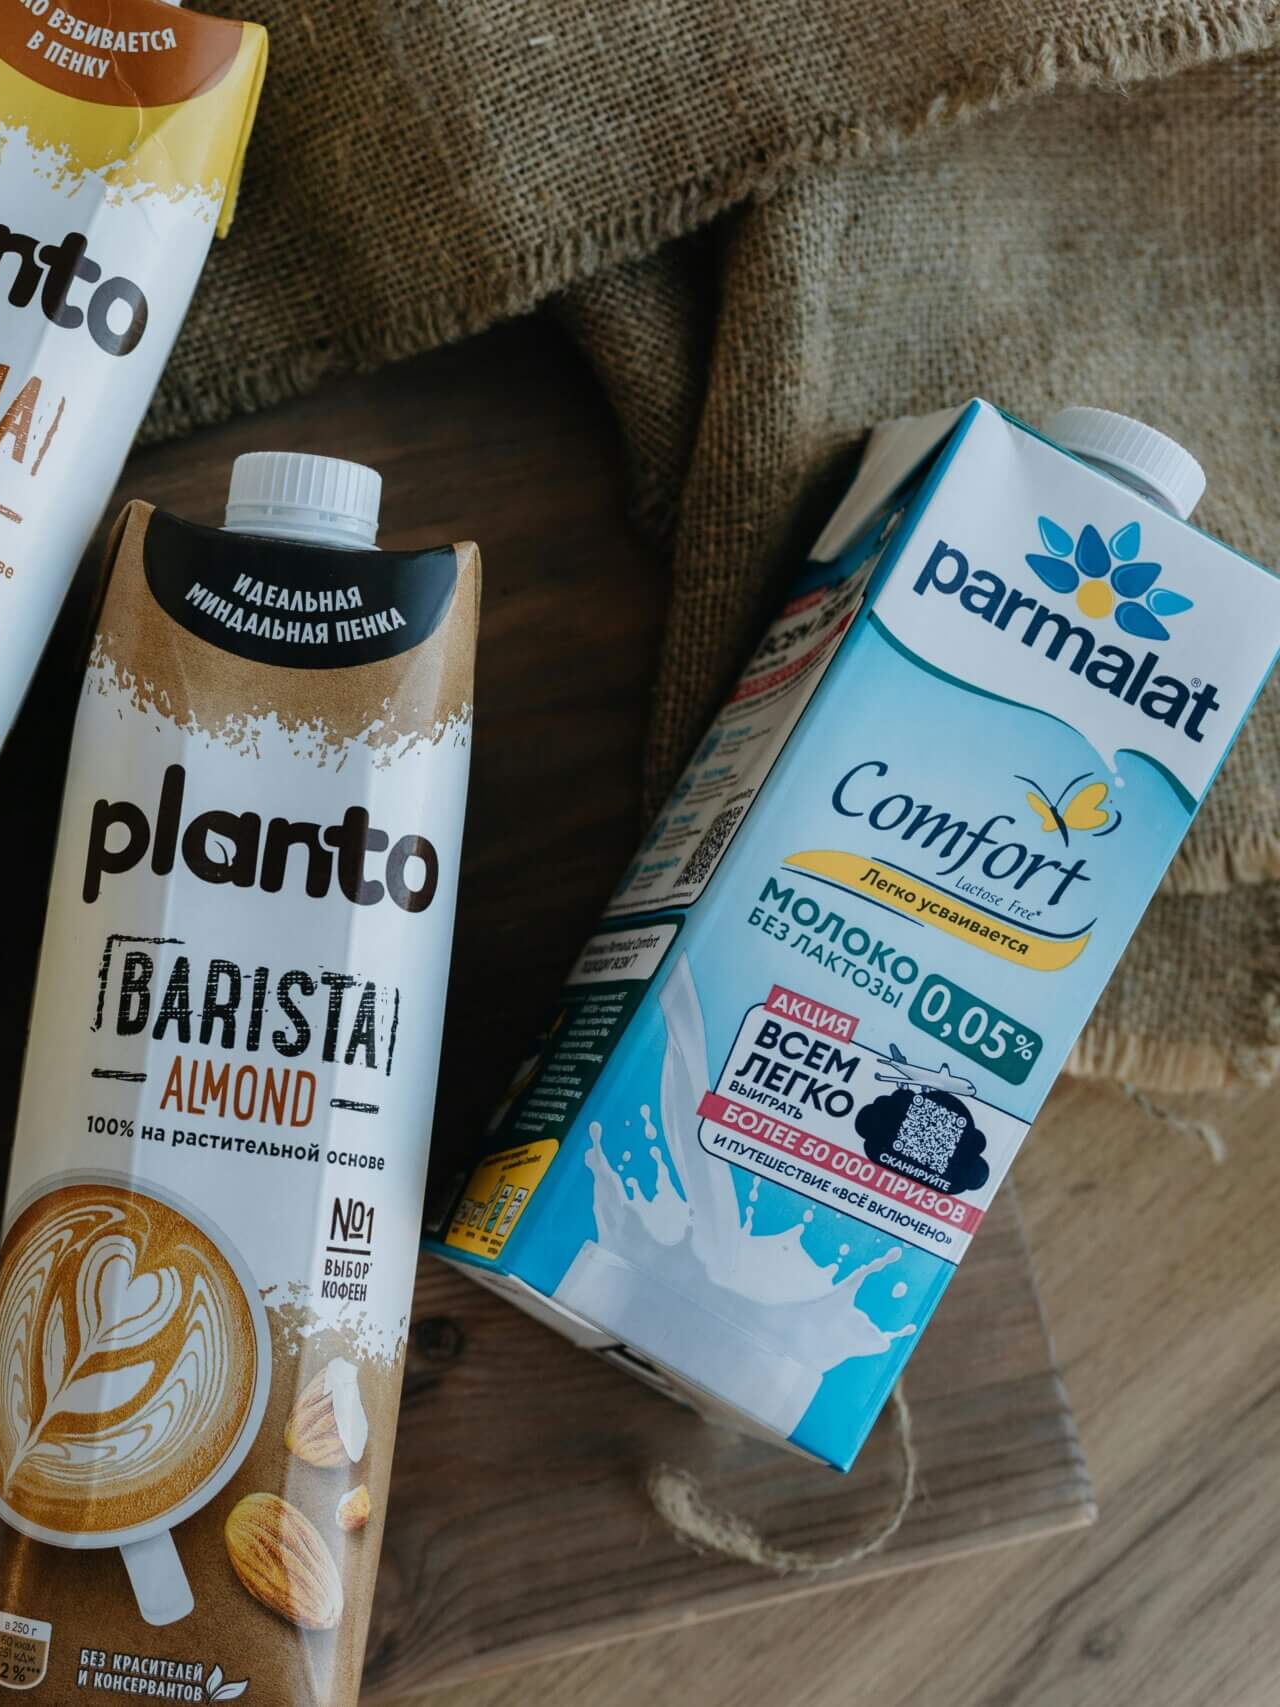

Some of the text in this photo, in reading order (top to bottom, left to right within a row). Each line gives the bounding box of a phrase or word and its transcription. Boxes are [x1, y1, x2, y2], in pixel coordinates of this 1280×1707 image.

[26, 30, 112, 79] В ПЕНКУ
[47, 7, 177, 53] ВЗБИВАЕТСЯ
[185, 581, 408, 645] МИНДАЛЬНАЯ ПЕНКА
[232, 573, 363, 613] ИДЕАЛЬНАЯ
[83, 764, 439, 913] planto
[831, 760, 1091, 907] Comfort
[859, 867, 1030, 956] Легко усваивается
[955, 874, 1004, 907] Lactose
[747, 908, 904, 1009] БЕЗ ЛАКТОЗЫ
[758, 876, 920, 985] МОЛОКО
[116, 951, 378, 1069] BARISTA
[771, 992, 853, 1039] АКЦИЯ
[920, 983, 1033, 1061] 0,05%
[754, 1018, 860, 1084] ВСЕМ
[159, 1055, 317, 1128] ALMOND
[728, 1079, 803, 1121] ВЫИГРАТЬ
[735, 1052, 855, 1118] ЛЕГКО
[87, 1115, 385, 1171] 100% на растительной основе
[713, 1133, 725, 1147] И
[726, 1138, 832, 1193] ПУТЕШЕСТВИЕ
[722, 1104, 967, 1225] БОЛЕЕ 50 000 ПРИЗОВ
[879, 1152, 951, 1191] СКАНИРУЙТЕ
[321, 1280, 367, 1301] КОФЕЕН
[12, 1621, 29, 1635] 250
[77, 1669, 203, 1702] И КОНСЕРВАНТОВ
[80, 1649, 203, 1682] БЕЗ КРАСИТЕЛЕЙ
